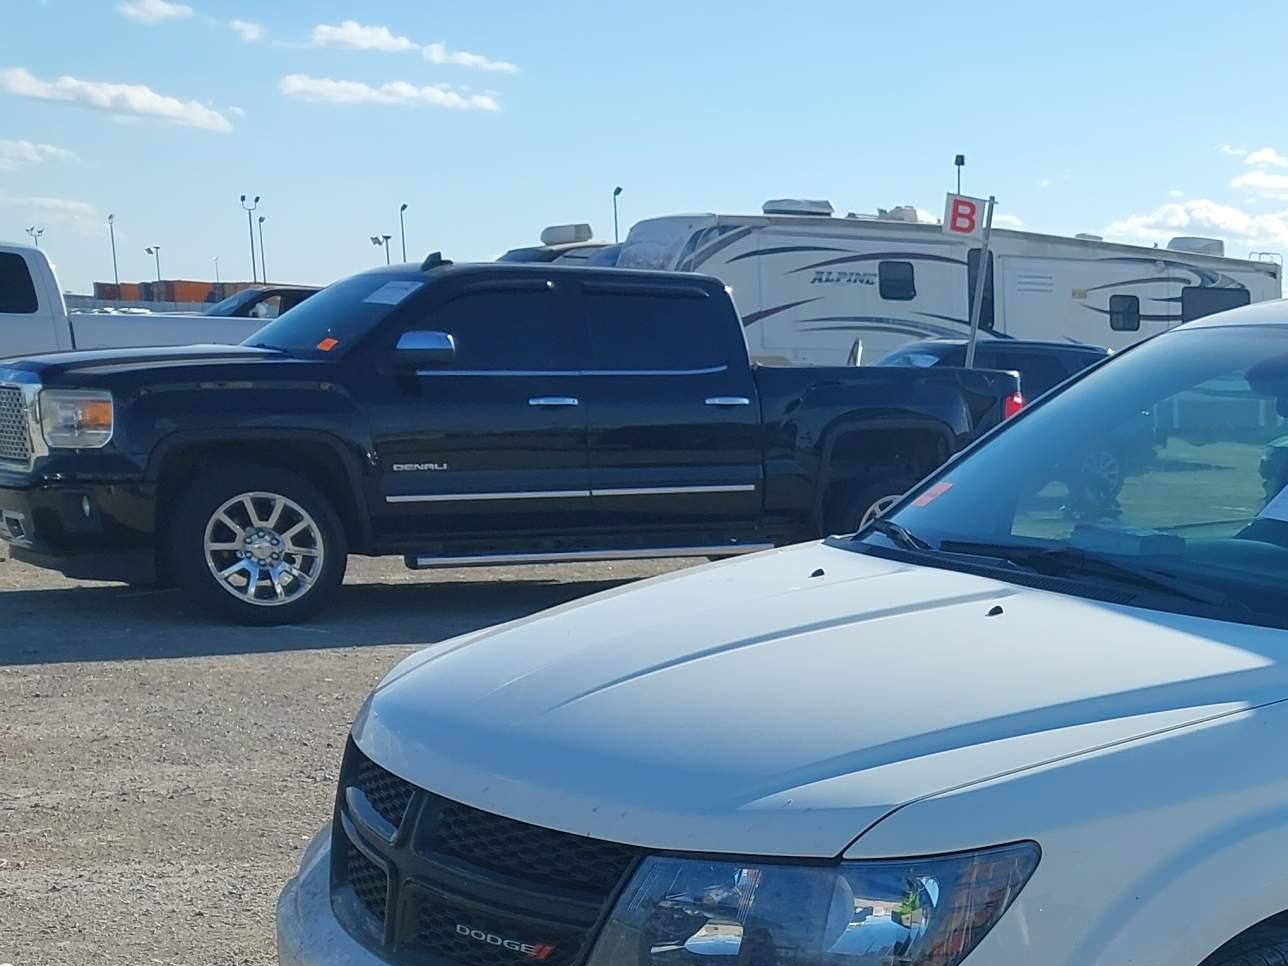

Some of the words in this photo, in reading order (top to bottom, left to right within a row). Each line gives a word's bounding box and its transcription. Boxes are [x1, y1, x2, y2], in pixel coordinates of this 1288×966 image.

[950, 199, 976, 233] B
[811, 271, 877, 285] ALPINE
[393, 462, 448, 471] DENALI
[456, 924, 536, 957] DODGE
